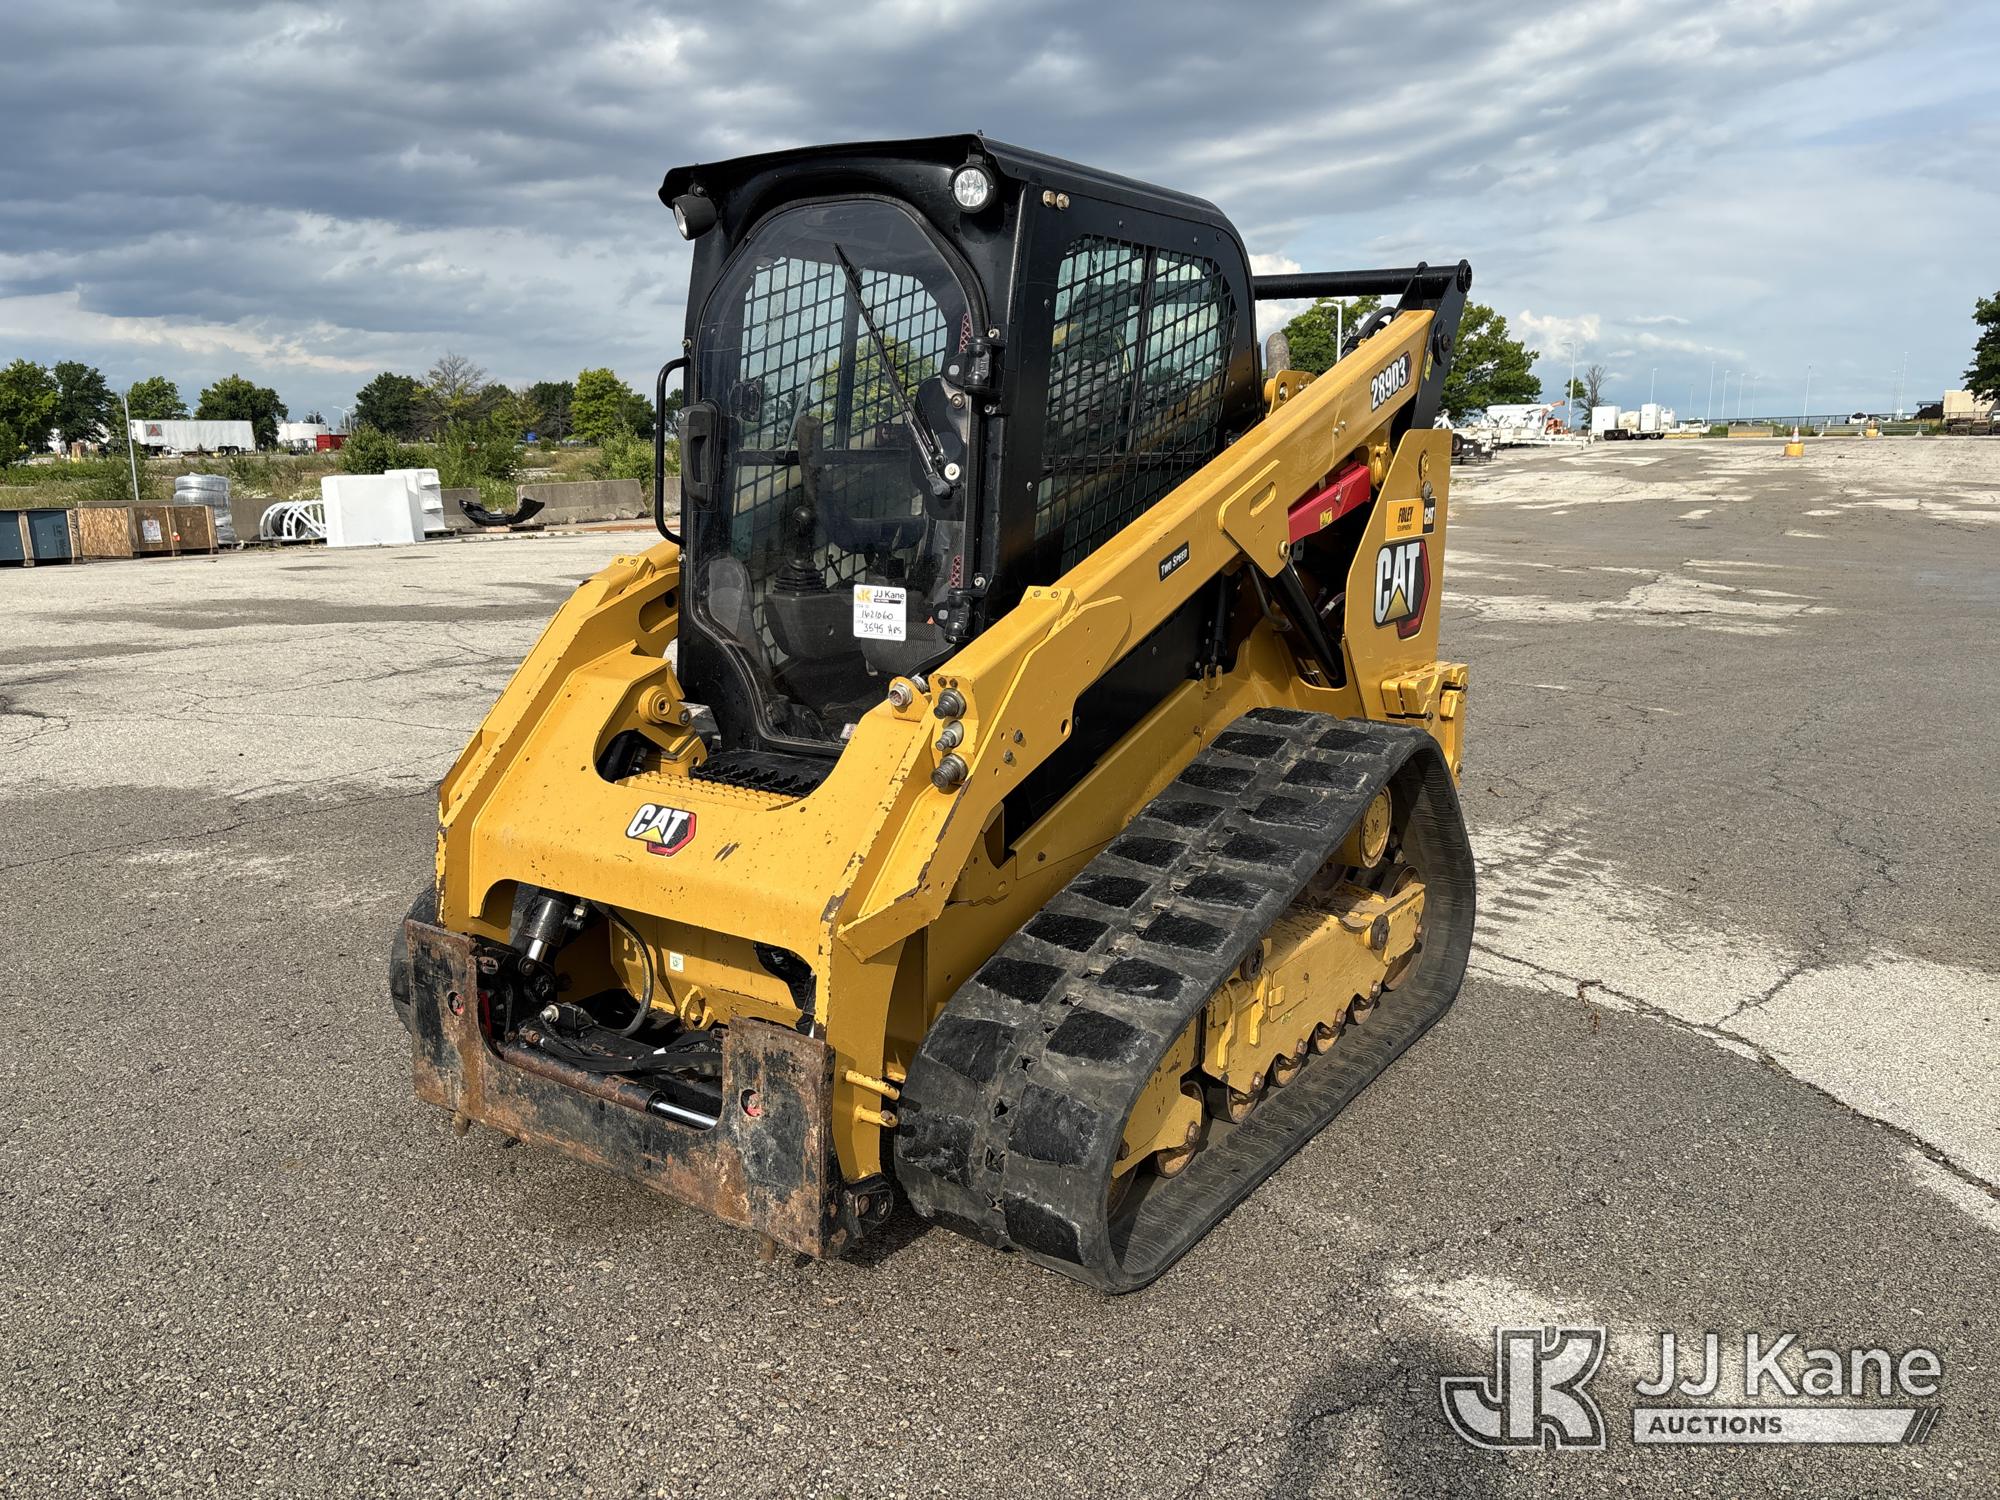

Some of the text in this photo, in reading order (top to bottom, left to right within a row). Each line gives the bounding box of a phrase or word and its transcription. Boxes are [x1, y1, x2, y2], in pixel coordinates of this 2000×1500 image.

[1424, 507, 1435, 525] CAT
[874, 589, 905, 600] JJ Kane
[1375, 542, 1420, 624] CAT
[626, 804, 690, 845] CAT
